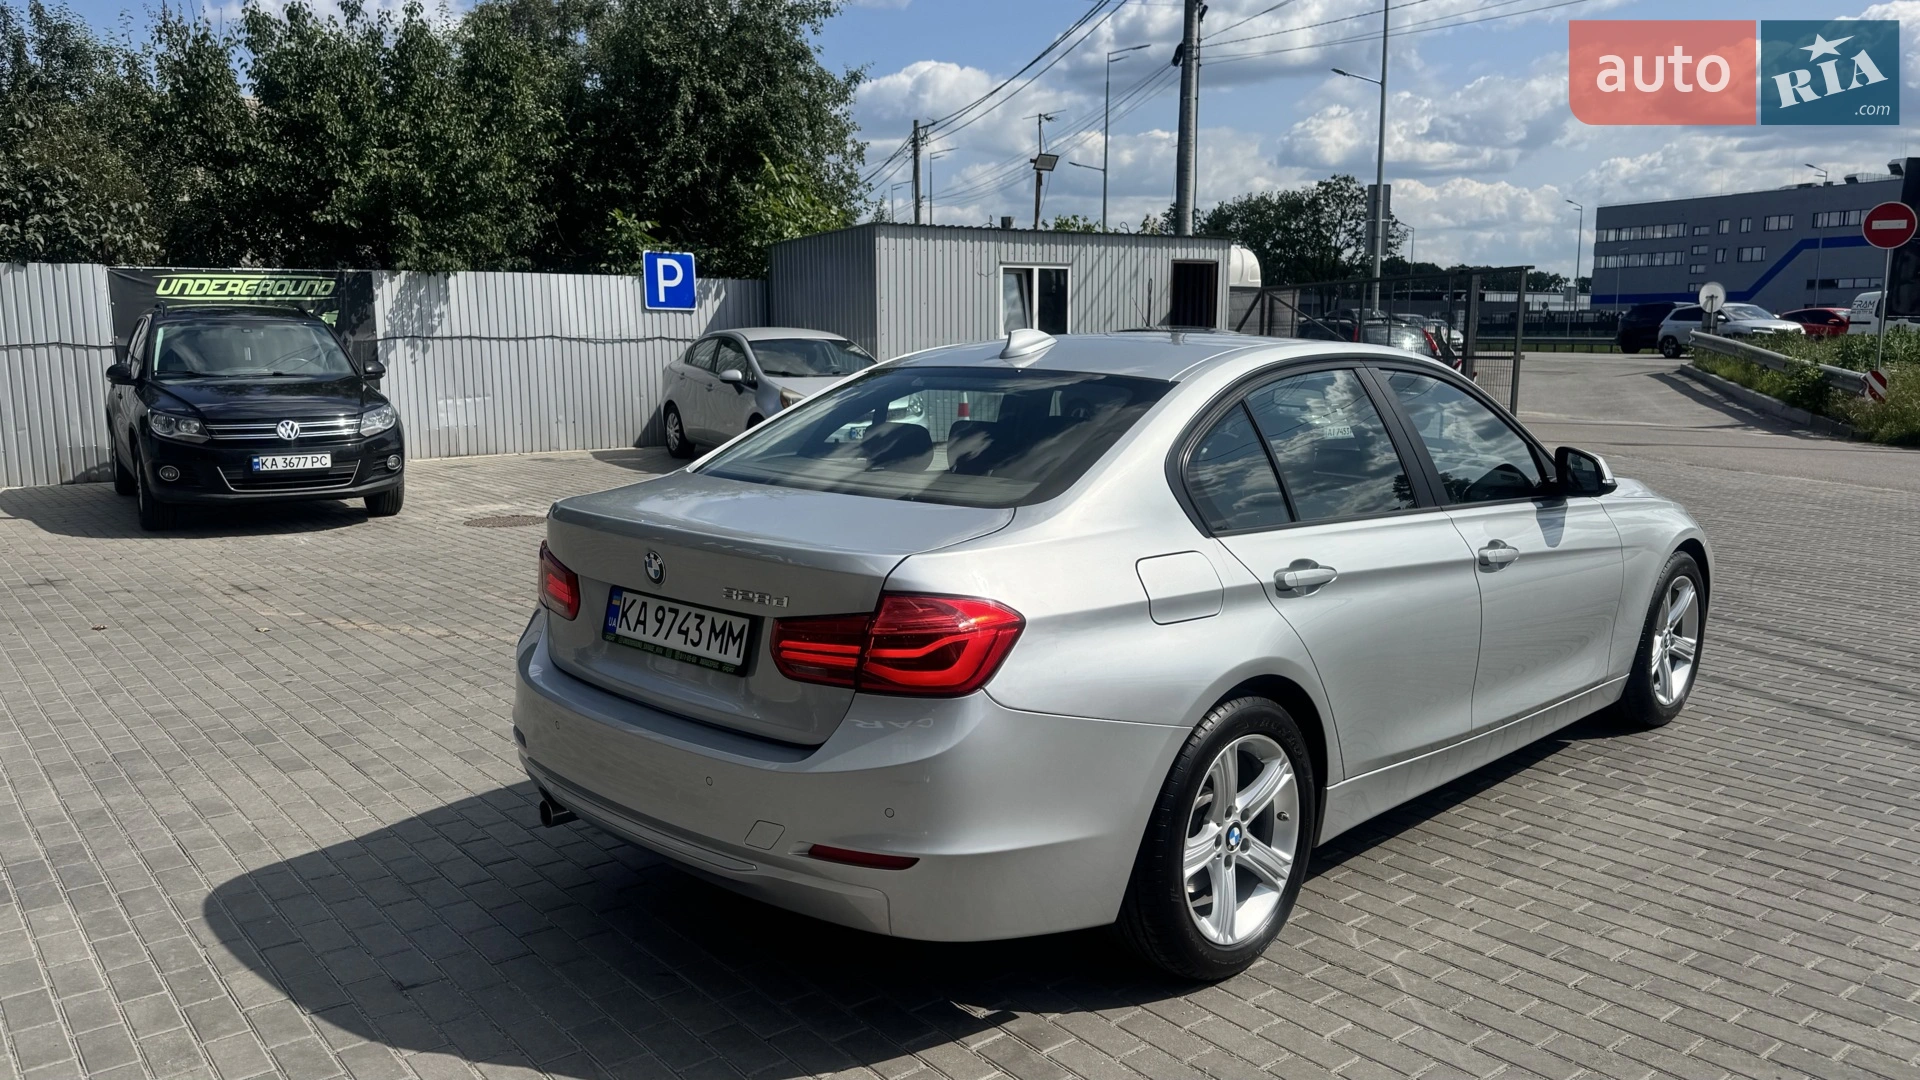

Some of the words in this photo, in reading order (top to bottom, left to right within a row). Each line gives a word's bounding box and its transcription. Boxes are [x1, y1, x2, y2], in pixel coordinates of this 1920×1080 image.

[155, 278, 336, 296] UNDERGROUND
[657, 257, 683, 302] P
[260, 457, 278, 469] KA
[282, 456, 308, 468] 3677
[311, 456, 328, 467] PC
[619, 597, 648, 635] KA
[652, 605, 706, 648] 9743
[706, 617, 746, 658] MM
